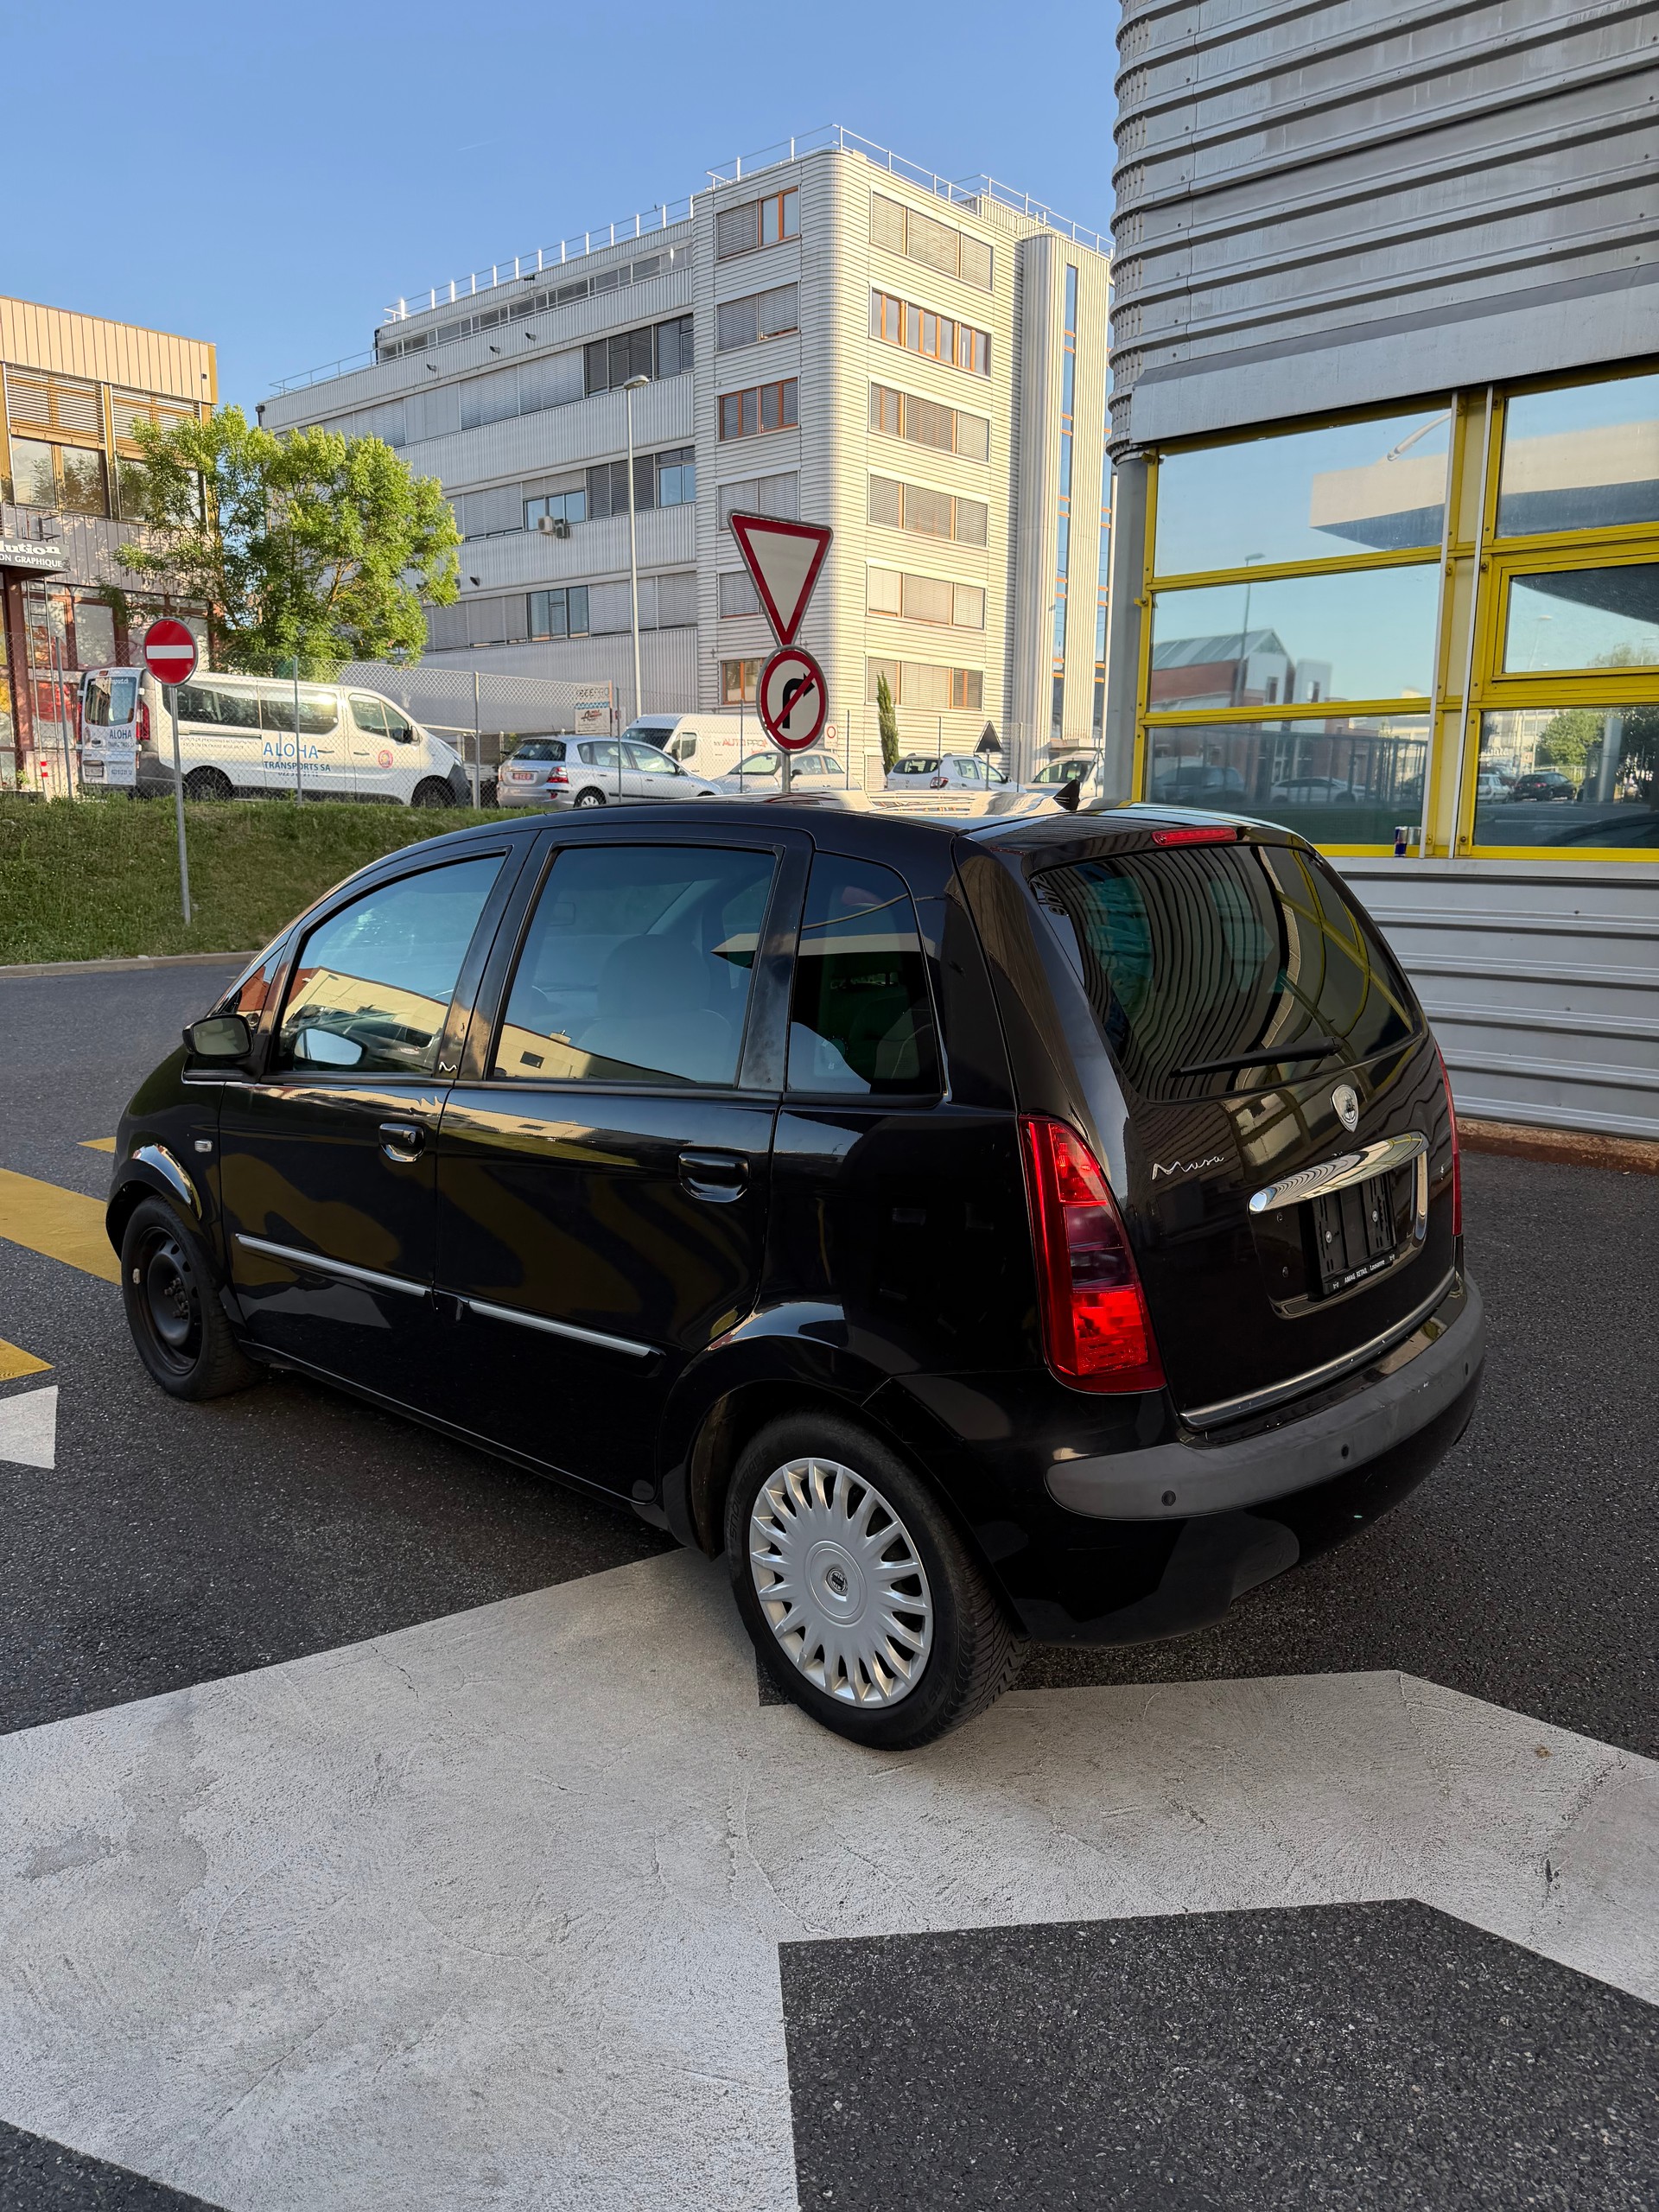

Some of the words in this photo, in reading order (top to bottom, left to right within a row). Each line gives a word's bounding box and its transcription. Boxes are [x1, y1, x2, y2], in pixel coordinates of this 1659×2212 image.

[14, 555, 63, 569] GRAPHIQUE
[109, 728, 132, 740] ALOHA
[263, 741, 319, 759] ALOHA
[320, 763, 331, 772] SA
[1151, 1156, 1224, 1180] Musa
[1344, 1272, 1356, 1284] AMAG
[1356, 1267, 1368, 1278] RETAIL
